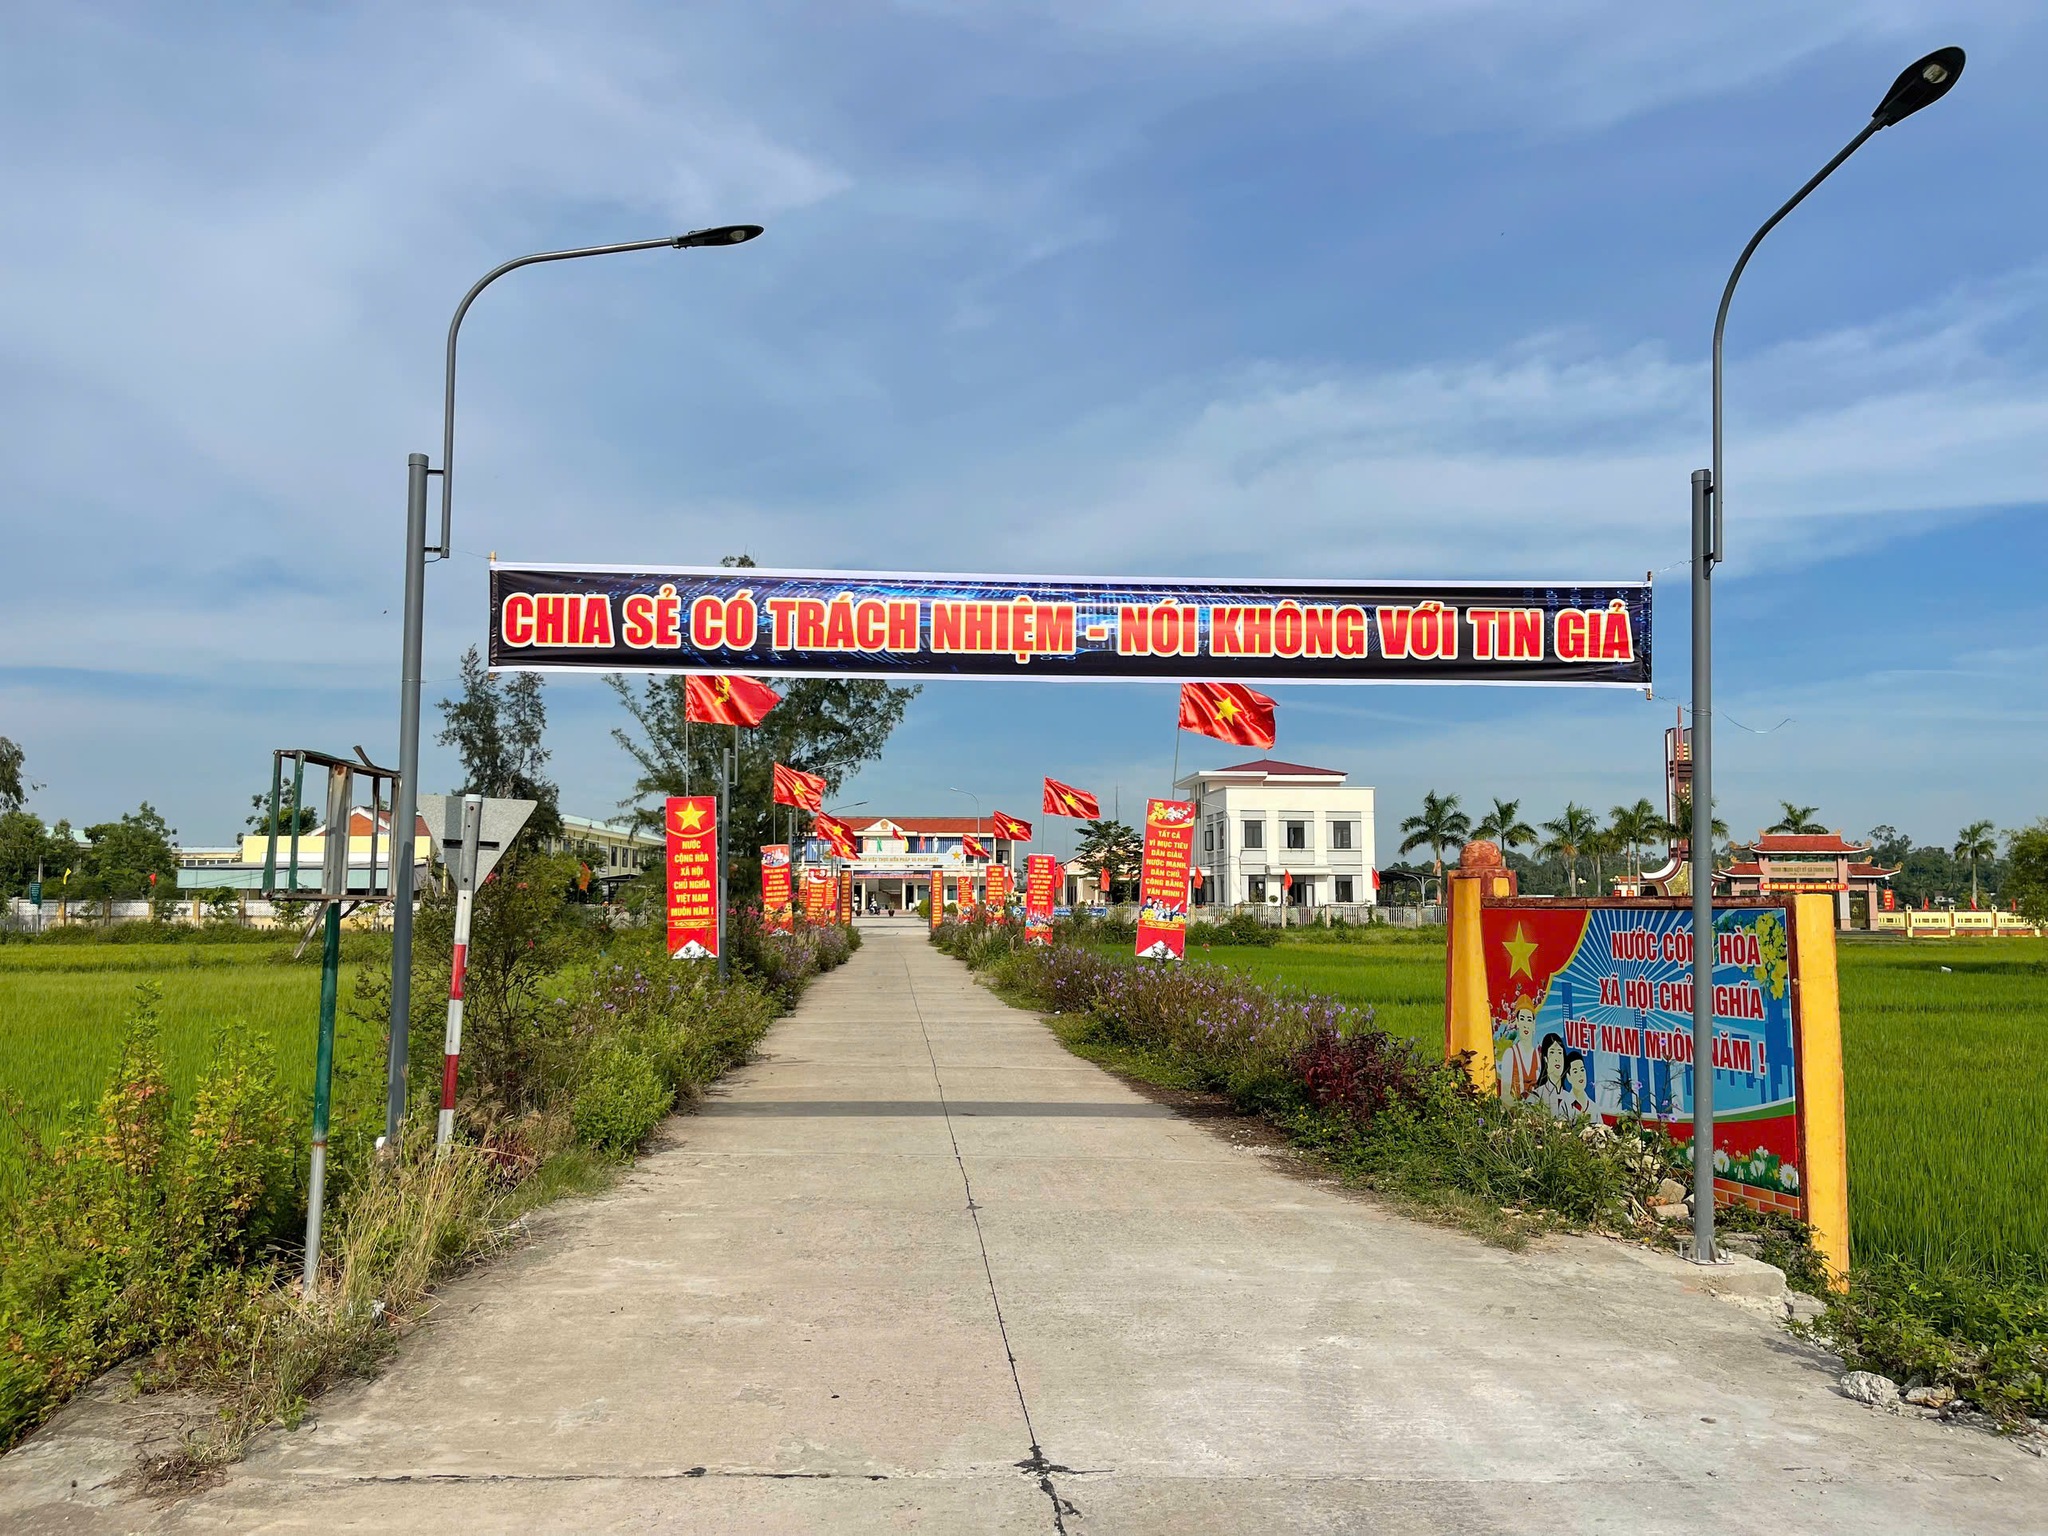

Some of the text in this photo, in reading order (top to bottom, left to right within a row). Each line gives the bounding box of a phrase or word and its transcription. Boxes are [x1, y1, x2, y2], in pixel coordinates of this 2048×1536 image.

[502, 583, 1635, 663] CHIA SẺ CÓ TRÁCH NHIỆM - NÓI KHÔNG VỚI TIN GIẢ
[1158, 830, 1170, 838] TẤT
[682, 840, 701, 849] NƯỚC
[1157, 840, 1173, 849] MỤC
[1174, 840, 1188, 850] TIÊU
[1151, 848, 1165, 857] DÂN
[674, 853, 694, 864] CỘNG
[1146, 858, 1164, 867] NƯỚC
[680, 866, 703, 877] XÃ HỘI
[1151, 868, 1165, 877] DÂN
[674, 879, 710, 889] CHỦ NGHĨA
[1145, 877, 1164, 886] CÔNG
[1146, 887, 1160, 896] VĂN
[1162, 889, 1179, 898] MINH
[676, 893, 708, 904] VIỆT NAM
[671, 906, 692, 916] MUÔN
[693, 906, 709, 916] NĂM
[1610, 926, 1762, 968] NƯỚC CỘN HÒA
[1598, 972, 1622, 1007] XÃ
[1625, 976, 1655, 1018] HỘI
[1564, 1017, 1597, 1056] VIỆT
[1601, 1025, 1640, 1058] NAM
